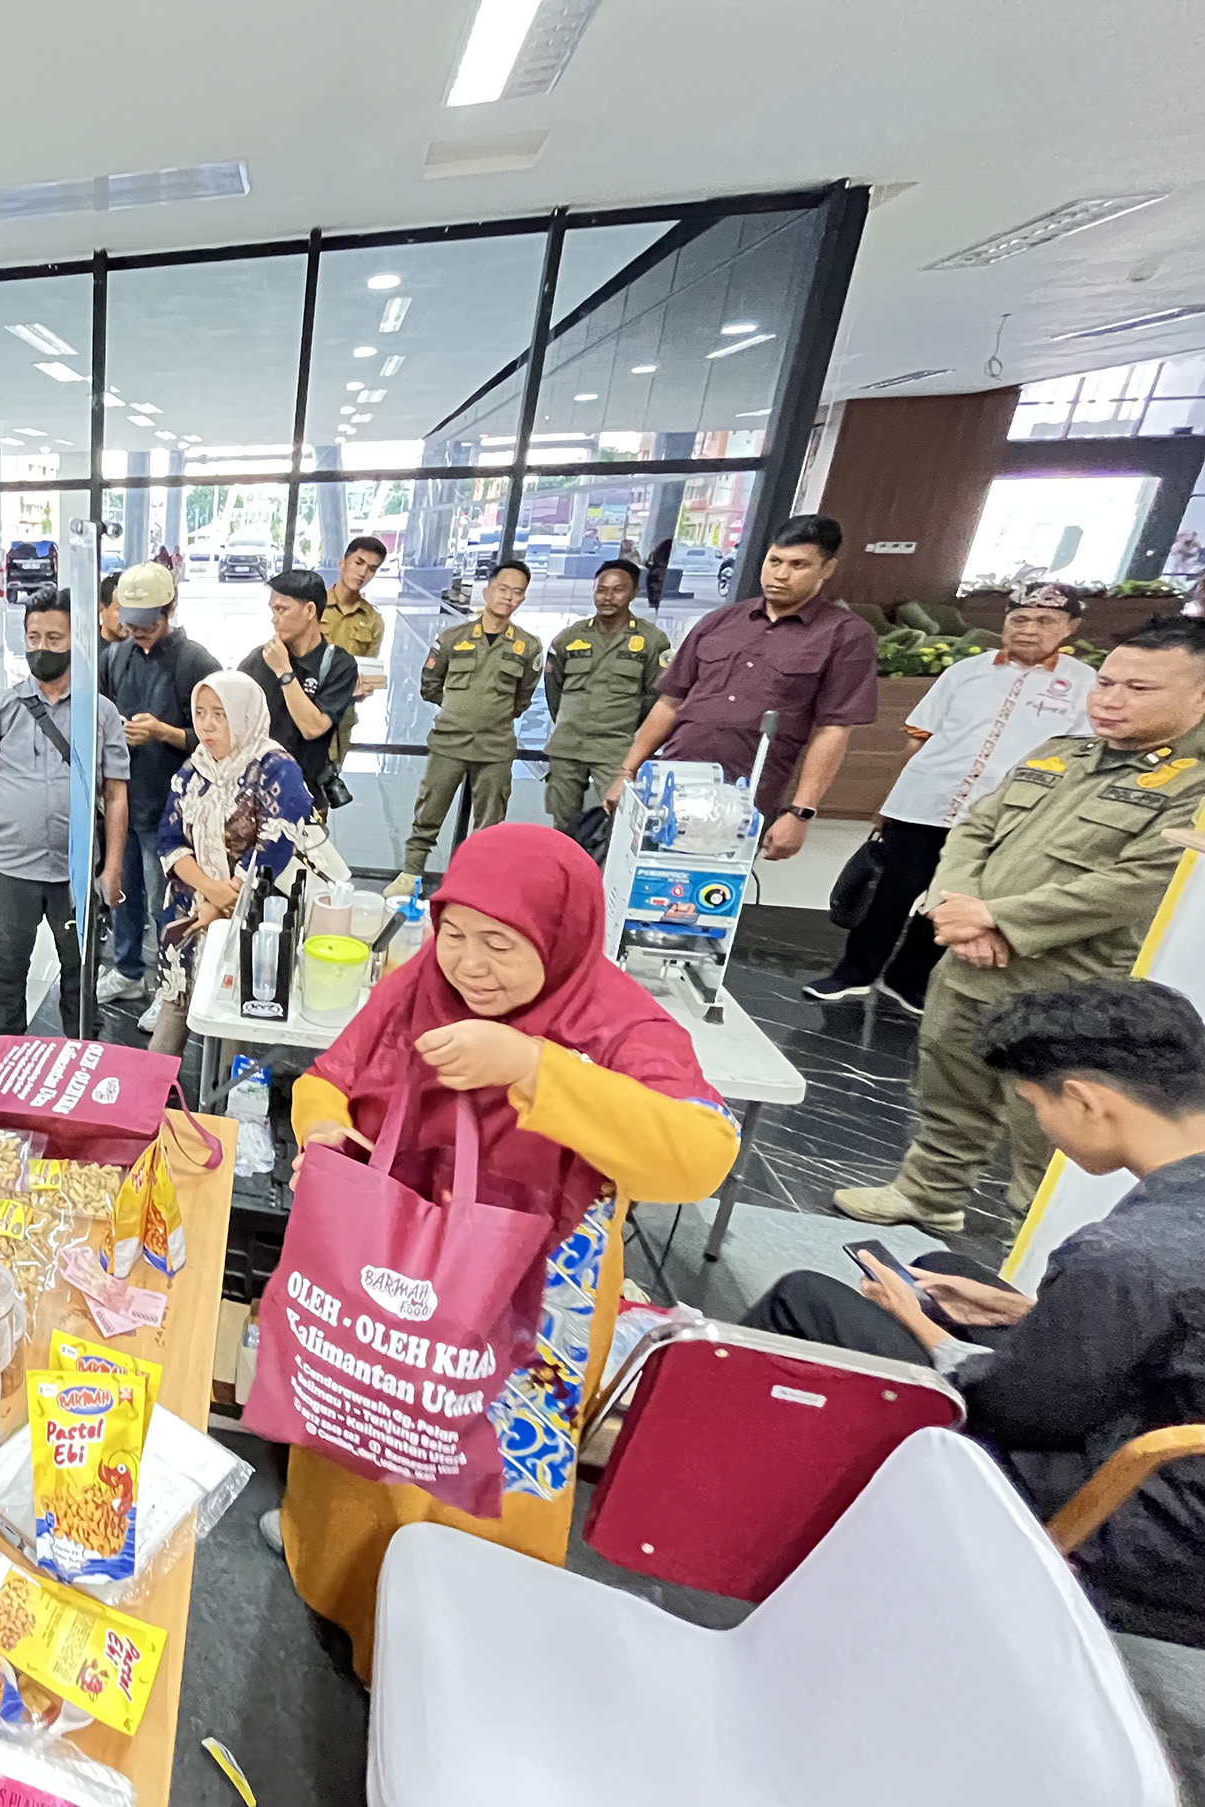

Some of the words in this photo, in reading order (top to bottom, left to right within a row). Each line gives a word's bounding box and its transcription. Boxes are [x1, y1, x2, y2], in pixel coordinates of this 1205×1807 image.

[364, 1269, 428, 1299] BARMAH
[287, 1271, 342, 1327] OLEH
[355, 1314, 430, 1368] OLEH
[286, 1307, 415, 1404] Kalimantan
[57, 1389, 111, 1409] BARMAH
[303, 1363, 392, 1418] Cenderawasih
[46, 1418, 104, 1443] Pastel
[346, 1415, 428, 1460] Kalimantan
[362, 1408, 420, 1446] Tanjung
[54, 1443, 85, 1466] Ebi
[104, 1630, 125, 1667] Ebi
[117, 1636, 140, 1701] Pastel
